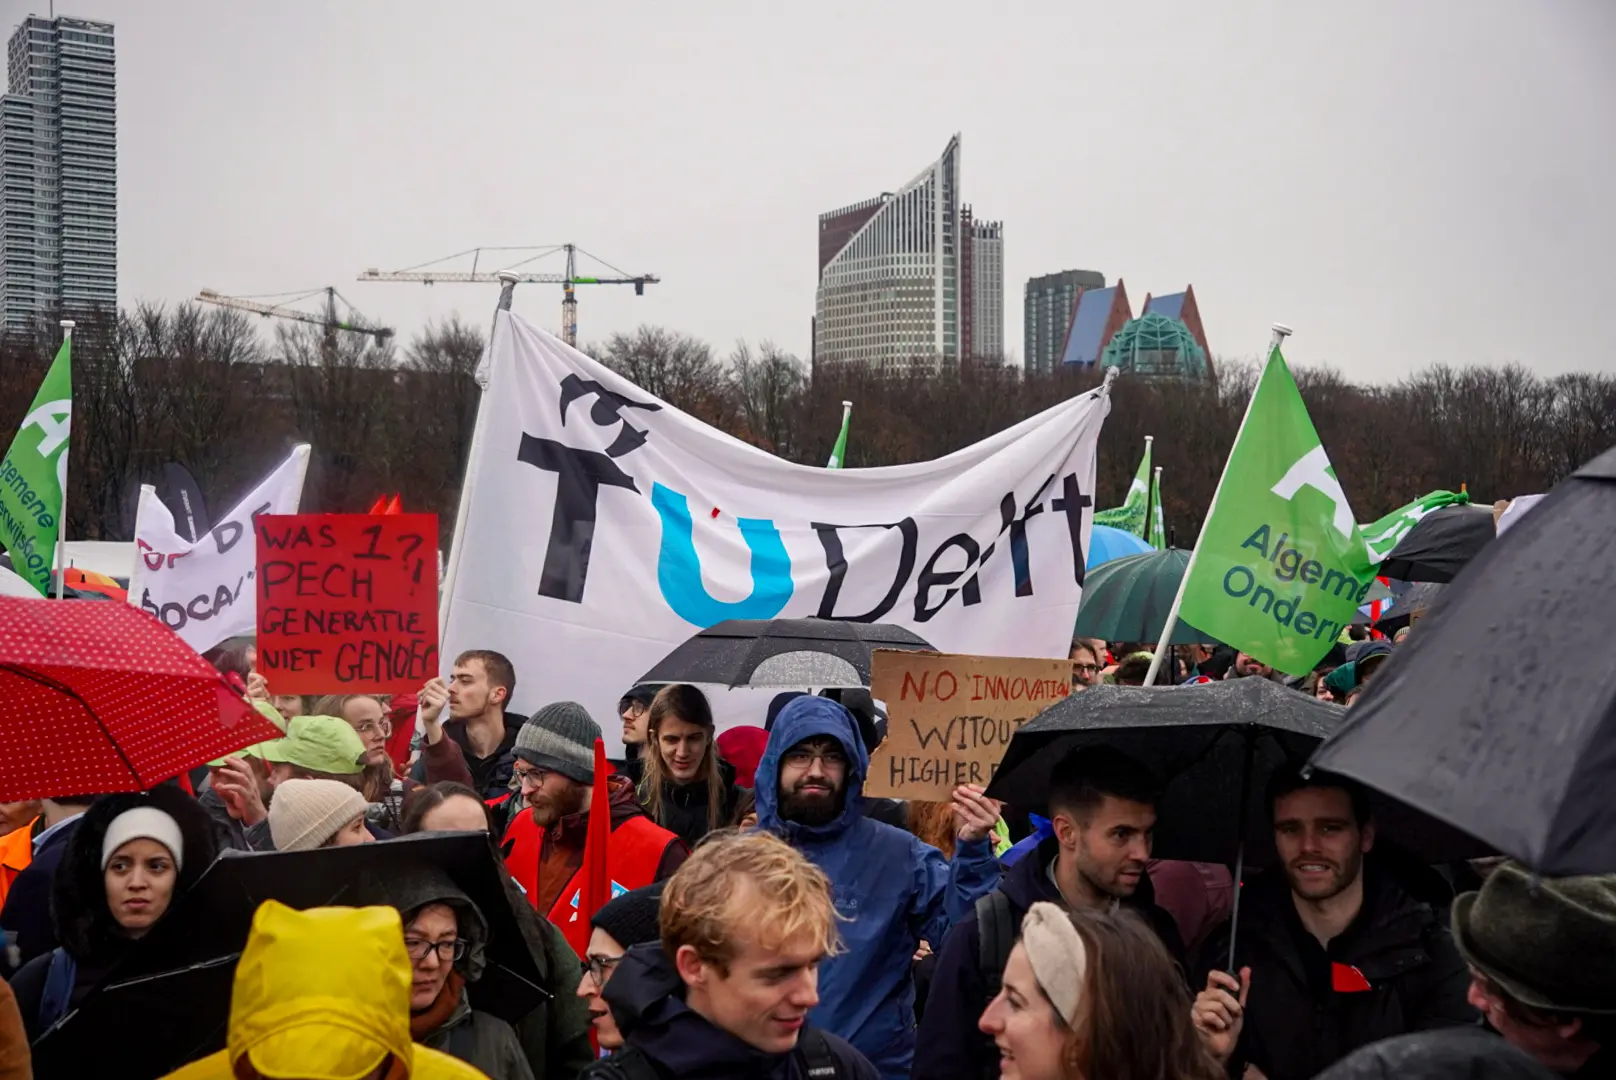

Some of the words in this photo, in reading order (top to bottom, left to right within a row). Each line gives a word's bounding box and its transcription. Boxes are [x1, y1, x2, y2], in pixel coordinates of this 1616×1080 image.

[261, 525, 337, 550] WAS
[517, 430, 795, 628] TU
[261, 560, 373, 603] PECH
[261, 606, 425, 636] GENERATIE
[262, 648, 323, 672] NIET
[900, 670, 958, 703] NO
[971, 674, 1070, 701] INNOVATION
[889, 755, 982, 787] HIGHER
